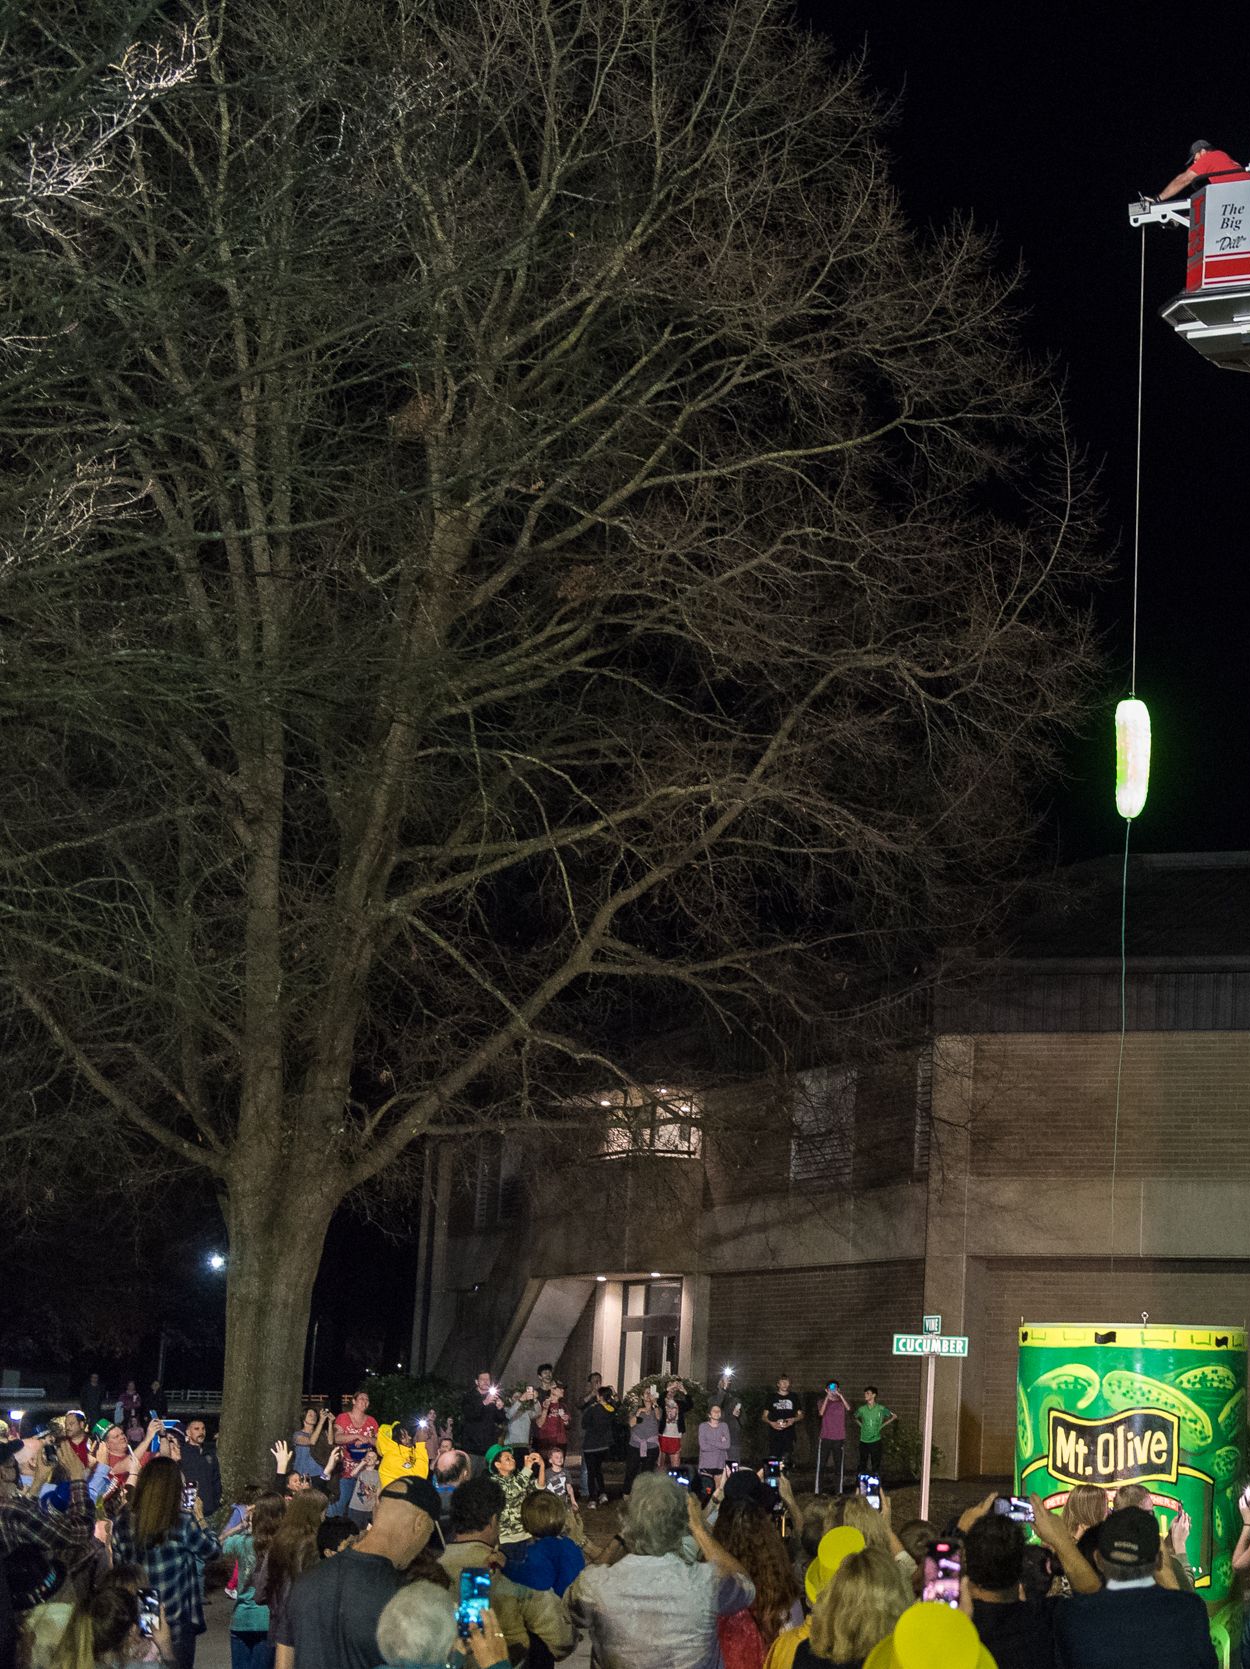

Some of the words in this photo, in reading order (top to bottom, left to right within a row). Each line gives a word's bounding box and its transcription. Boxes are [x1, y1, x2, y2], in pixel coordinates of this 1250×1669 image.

[1220, 203, 1245, 216] The
[1220, 217, 1242, 231] Big
[898, 1338, 964, 1353] CUCUMBER
[1056, 1425, 1093, 1475] Mt.
[1096, 1424, 1168, 1475] Olive
